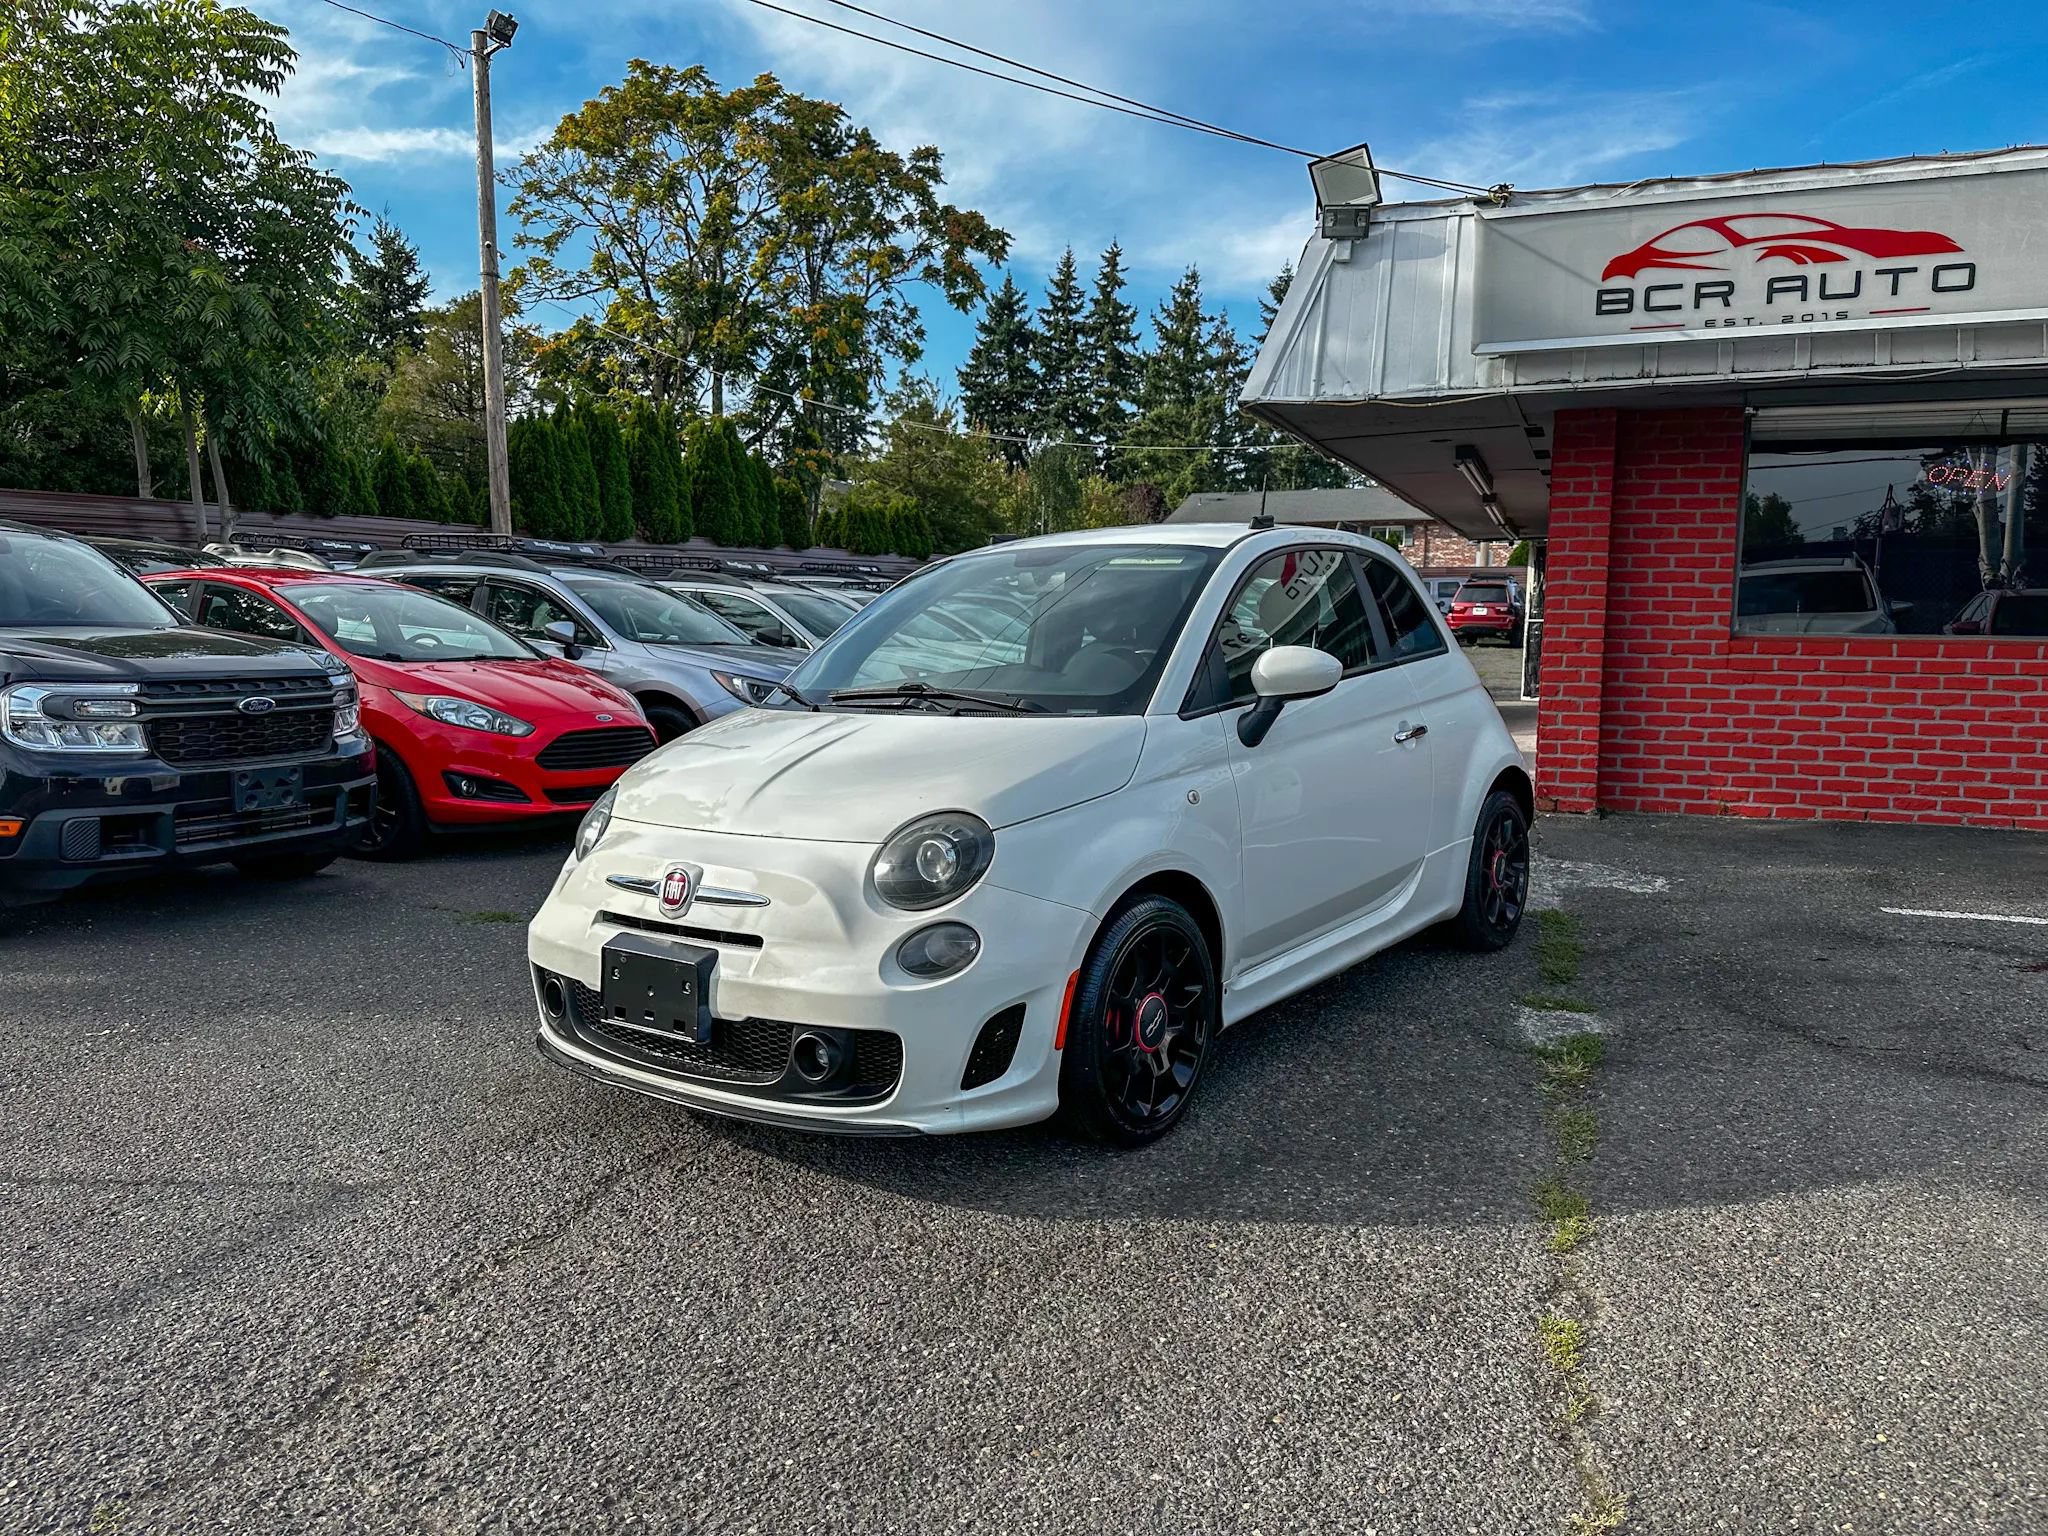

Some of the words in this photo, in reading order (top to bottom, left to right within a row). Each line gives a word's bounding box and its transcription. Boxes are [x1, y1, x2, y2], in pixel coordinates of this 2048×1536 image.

[1596, 281, 1734, 315] BCR
[1767, 263, 1975, 304] AUTO
[1705, 317, 1762, 328] EST.
[1781, 311, 1849, 323] 2015
[1928, 466, 2012, 491] OPEN
[249, 700, 269, 711] Ford
[664, 880, 685, 900] FIAT
